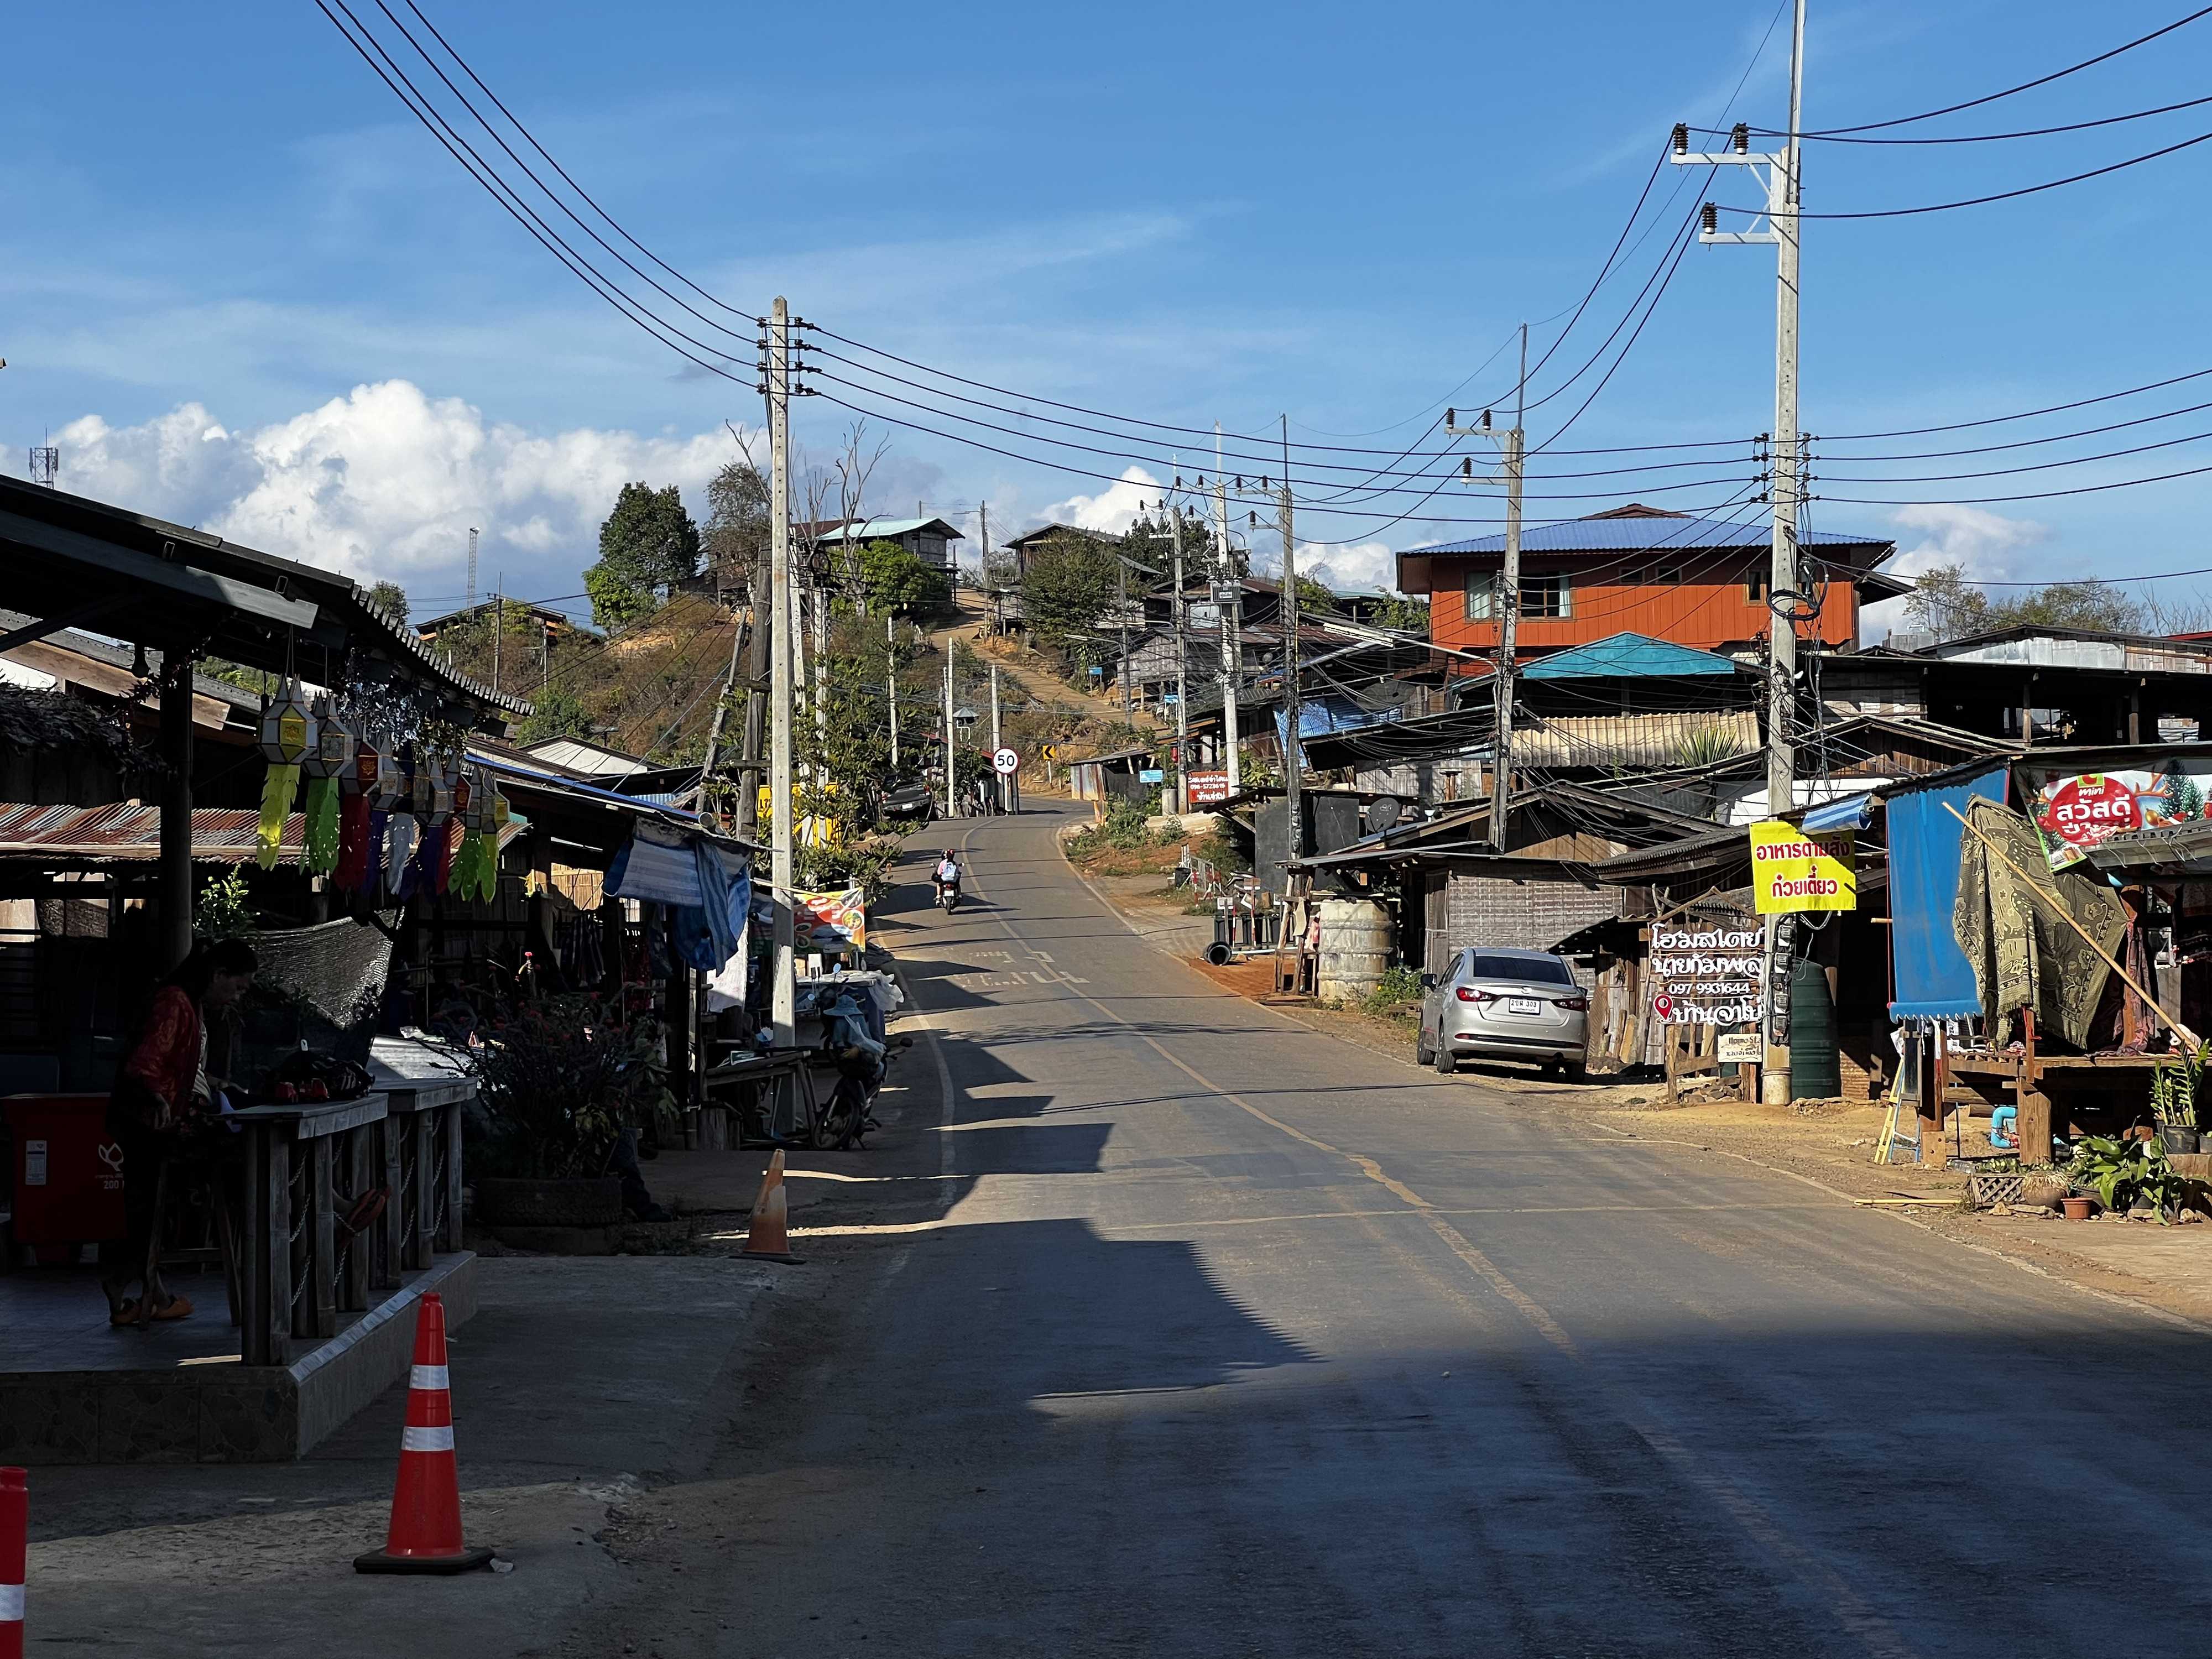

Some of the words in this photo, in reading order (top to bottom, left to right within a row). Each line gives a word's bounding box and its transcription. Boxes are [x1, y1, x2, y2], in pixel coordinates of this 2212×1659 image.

[998, 755, 1015, 766] 50
[2079, 786, 2105, 796] mini
[2057, 794, 2131, 821] สวัสดี
[1772, 865, 1838, 896] ก๋วยเตี๋ยว
[1651, 923, 1766, 948] โฮมสเตย์
[1669, 983, 1693, 994] 097
[1696, 982, 1750, 994] 9931644
[103, 1180, 119, 1189] 200
